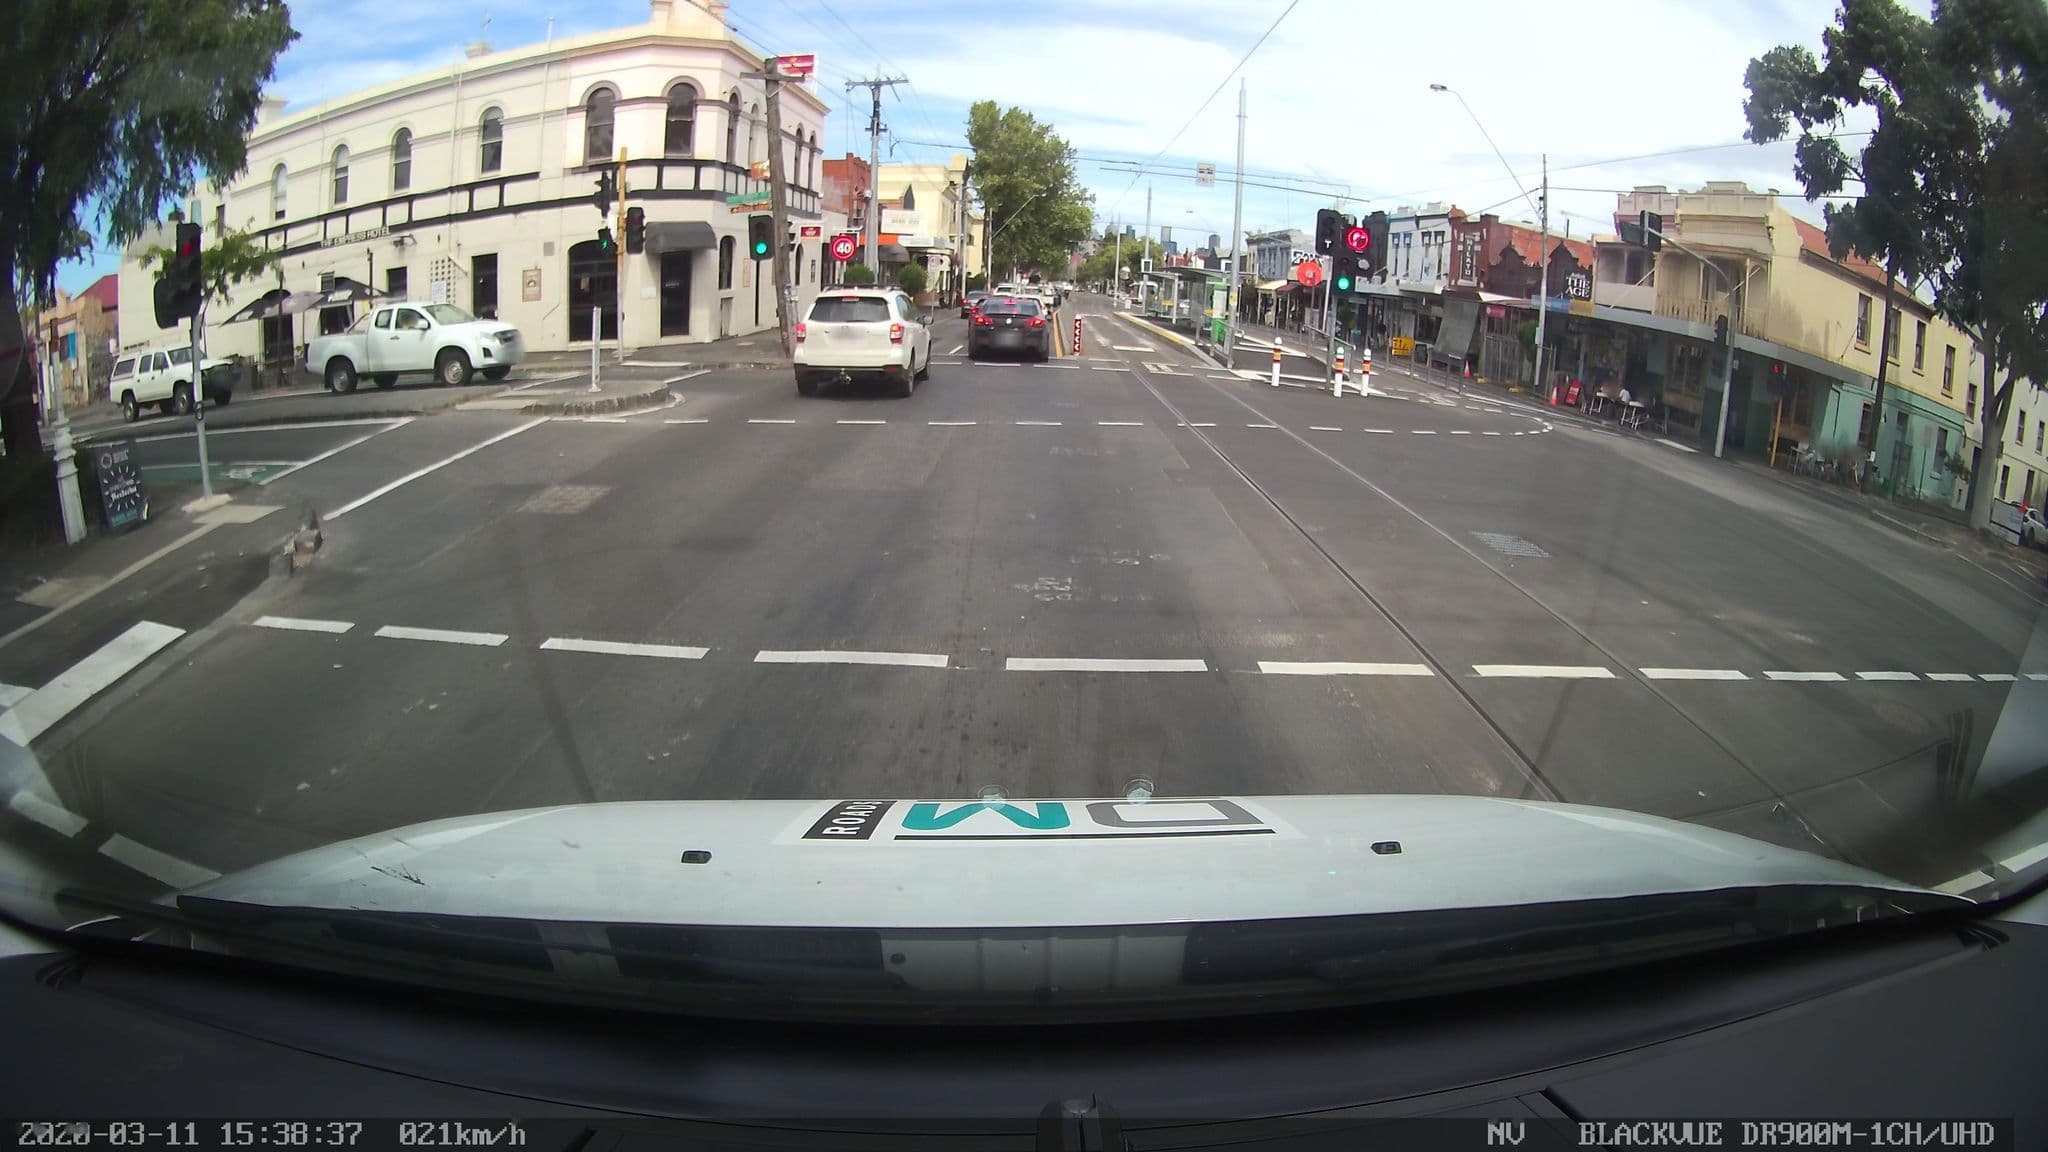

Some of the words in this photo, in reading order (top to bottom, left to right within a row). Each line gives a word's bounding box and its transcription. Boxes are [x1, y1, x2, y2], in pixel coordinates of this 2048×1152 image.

[366, 226, 390, 240] HOTEL
[836, 242, 852, 254] 40
[1565, 276, 1590, 290] THE
[1565, 286, 1590, 298] AGE
